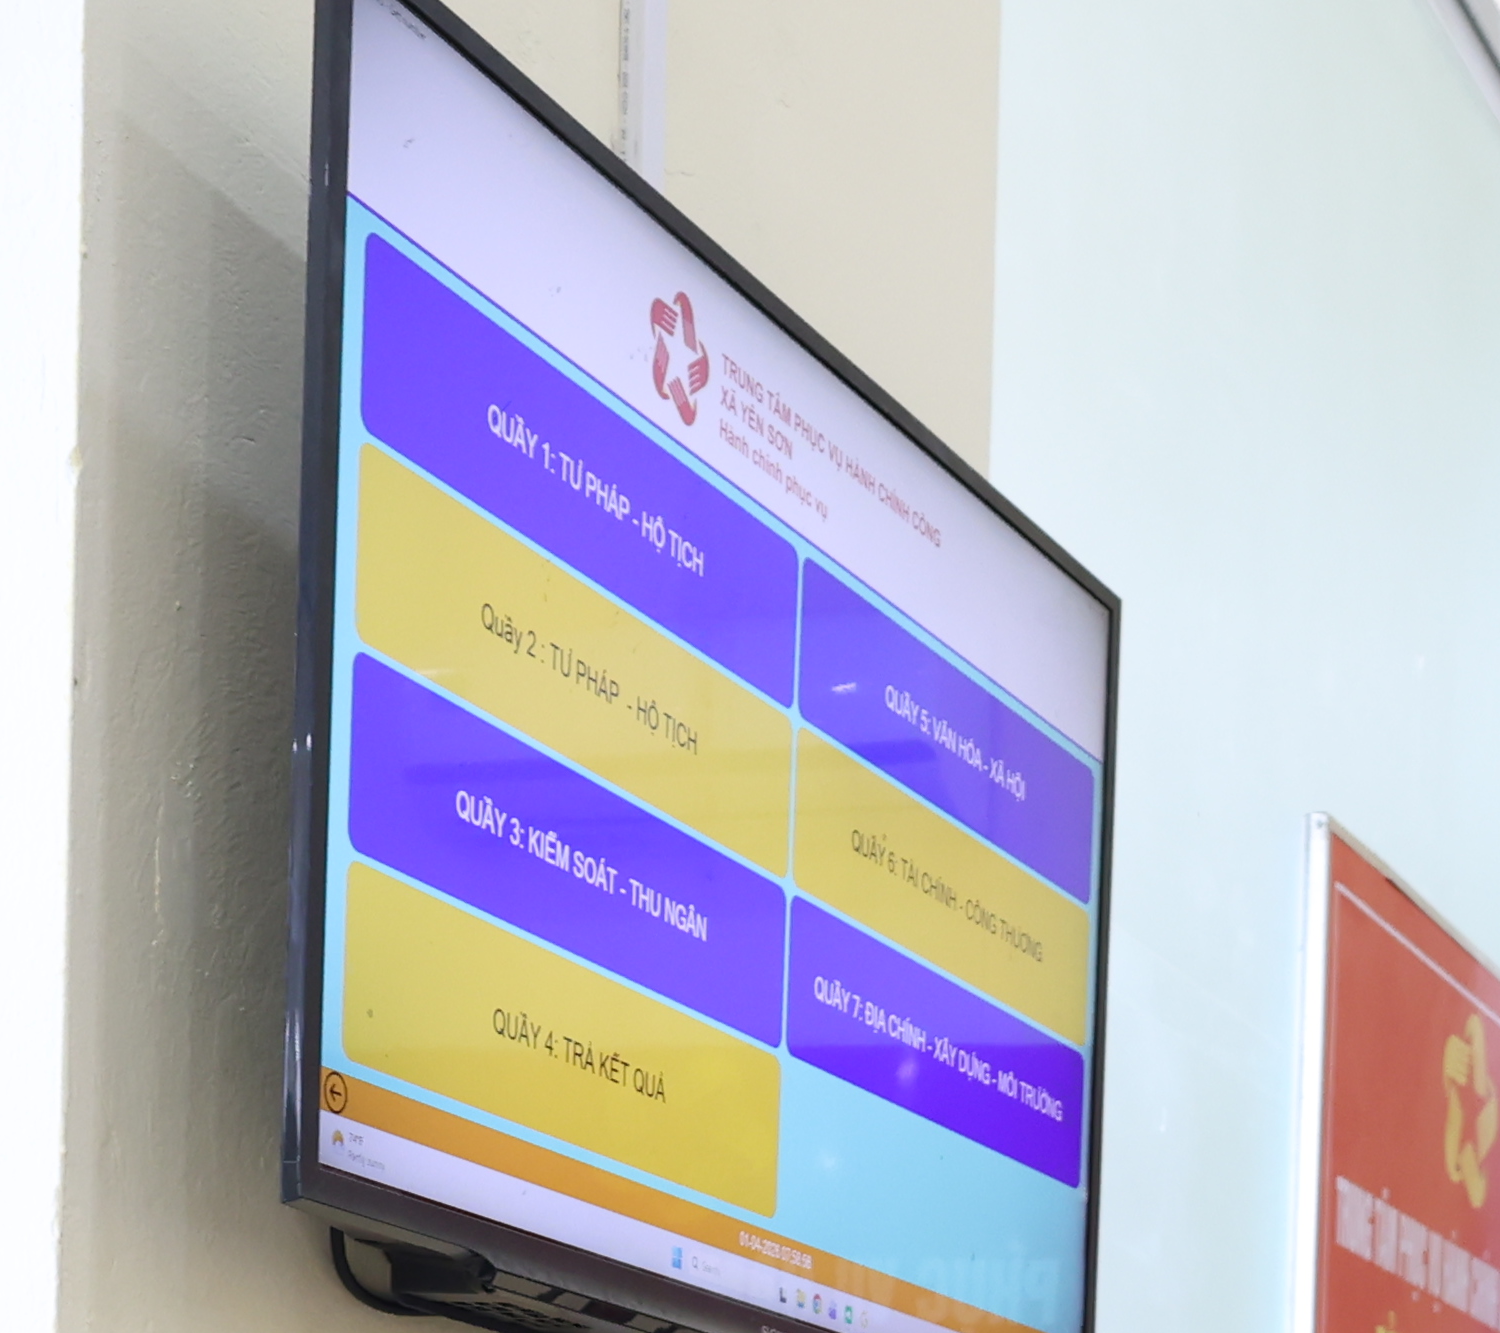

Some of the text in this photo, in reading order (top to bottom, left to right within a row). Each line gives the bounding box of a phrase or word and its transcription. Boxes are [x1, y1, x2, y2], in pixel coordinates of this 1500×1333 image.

[488, 404, 537, 458] QUẦY
[542, 442, 556, 474] 1:
[559, 452, 583, 490] TƯ
[586, 472, 630, 520] PHÁP
[641, 511, 665, 552] HỘ
[668, 529, 704, 577] TỊCH
[720, 418, 828, 522] Hành chính phục vụ
[721, 386, 793, 459] XÃ YÊN SƠN
[722, 353, 941, 547] TRUNG TÂM PHỤC VỤ HÀNH CHÍNH CÔNG
[481, 603, 523, 654] Quầy
[527, 631, 536, 658] 2
[550, 642, 572, 678] TƯ
[576, 659, 619, 704] PHÁP
[637, 696, 659, 736] HỘ
[663, 712, 698, 755] TỊCH
[885, 685, 919, 725] QUẦY
[920, 709, 931, 735] 5:
[933, 716, 957, 753] VĂN
[958, 736, 983, 771] HÓA
[990, 758, 1004, 788] XÃ
[1007, 769, 1025, 801] HỘI
[456, 790, 506, 837] QUẦY
[510, 817, 525, 849] 3:
[573, 851, 618, 894] SOÁT
[629, 878, 662, 917] THU
[664, 897, 708, 942] NGÂN
[493, 1008, 666, 1103] QUẦY 4: TRẢ KẾT QUẢ
[814, 976, 850, 1013] QUẦY
[853, 994, 863, 1021] 7:
[864, 1001, 886, 1033] ĐỊA
[888, 1014, 926, 1052] CHÍNH
[933, 1037, 958, 1067] XÂY
[958, 1050, 991, 1085] DỰNG
[998, 1070, 1017, 1099] MÔI
[1020, 1081, 1063, 1121] TRƯỜNG
